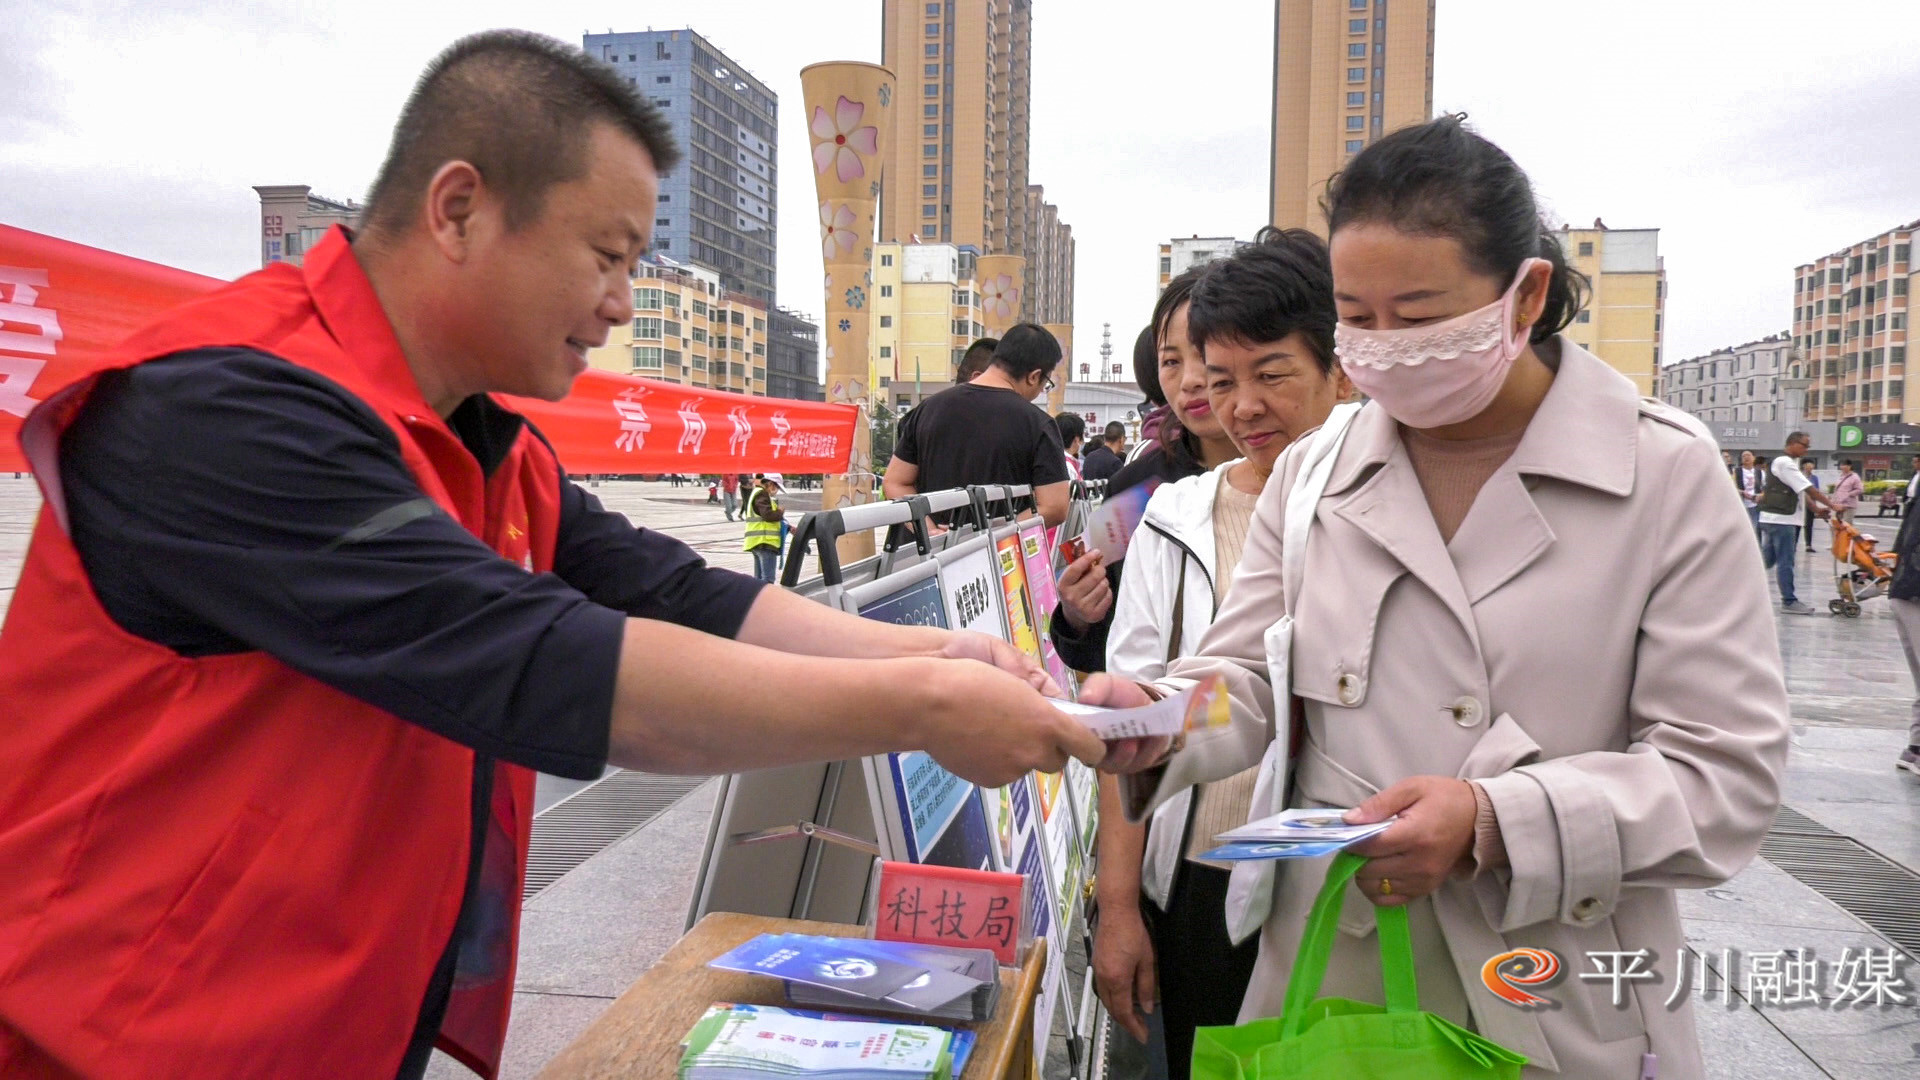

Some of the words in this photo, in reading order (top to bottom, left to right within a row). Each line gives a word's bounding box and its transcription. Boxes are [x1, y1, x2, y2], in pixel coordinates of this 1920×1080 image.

[612, 386, 791, 459] 崇尚科学
[1866, 434, 1911, 446] 德克士
[887, 886, 1015, 947] 科技局
